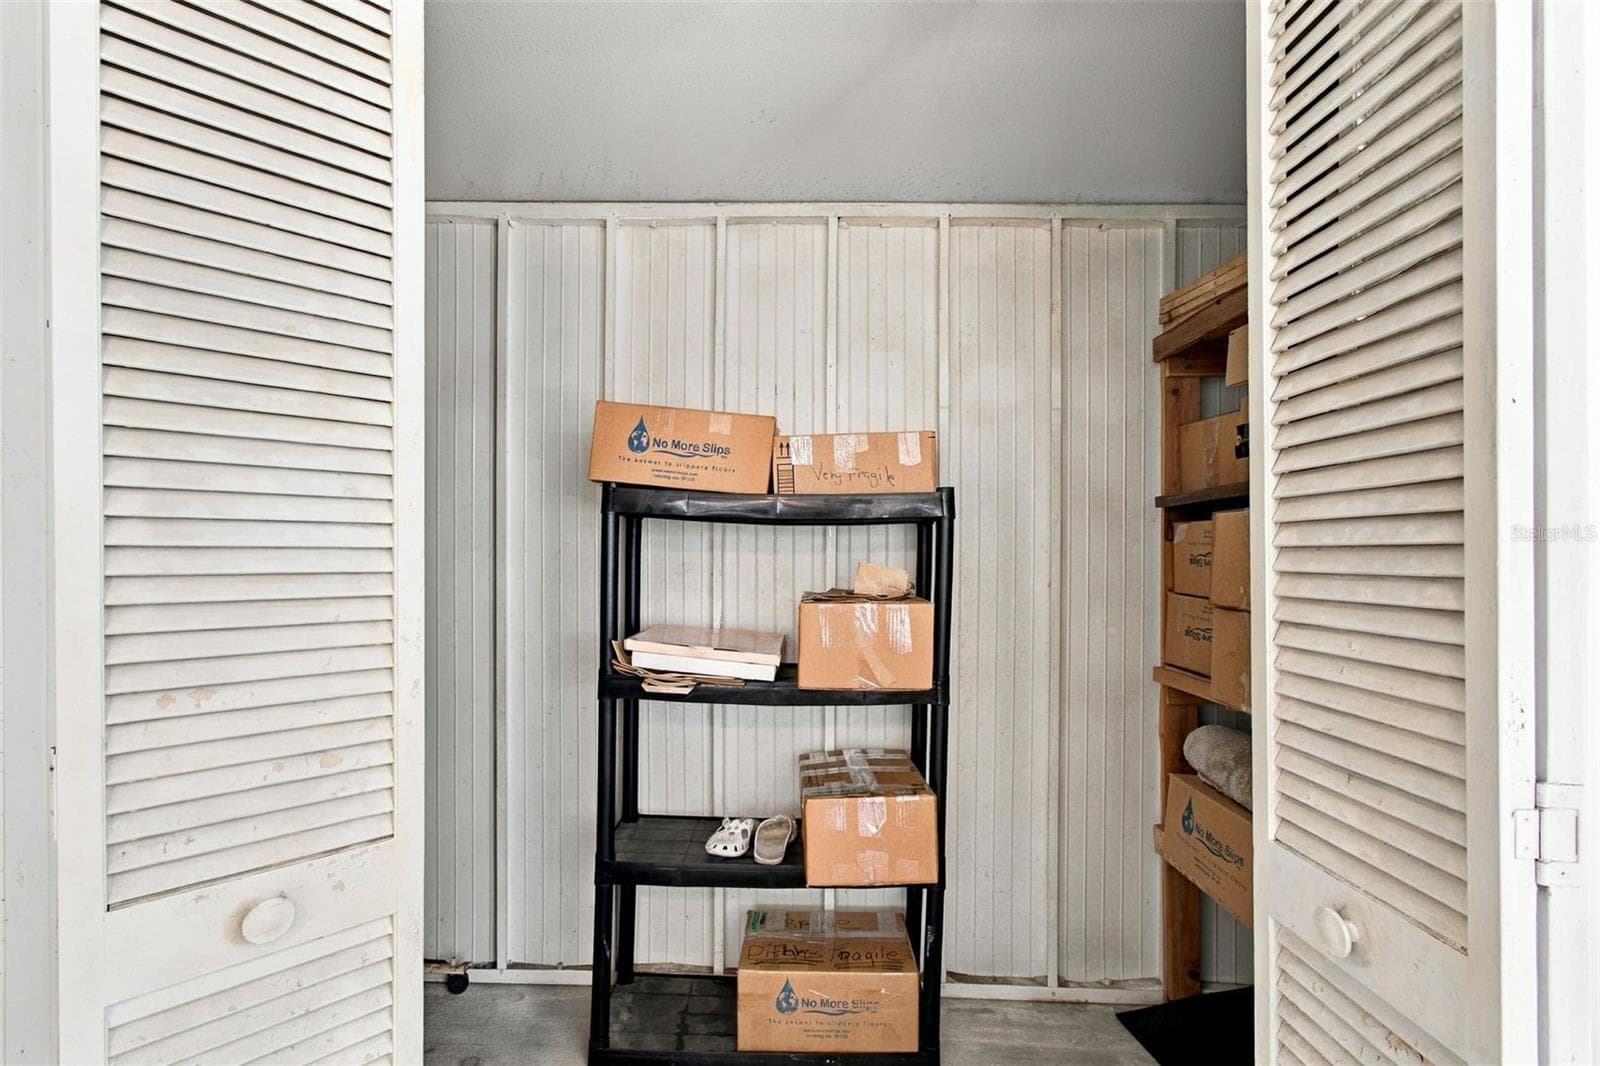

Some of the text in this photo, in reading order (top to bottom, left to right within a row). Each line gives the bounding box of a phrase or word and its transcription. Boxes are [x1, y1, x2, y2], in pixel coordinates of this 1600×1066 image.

[652, 437, 731, 456] No More Slips
[811, 462, 895, 488] Very Fragile
[1195, 822, 1205, 838] No
[1205, 827, 1224, 851] More
[801, 996, 818, 1009] No
[820, 997, 849, 1009] More
